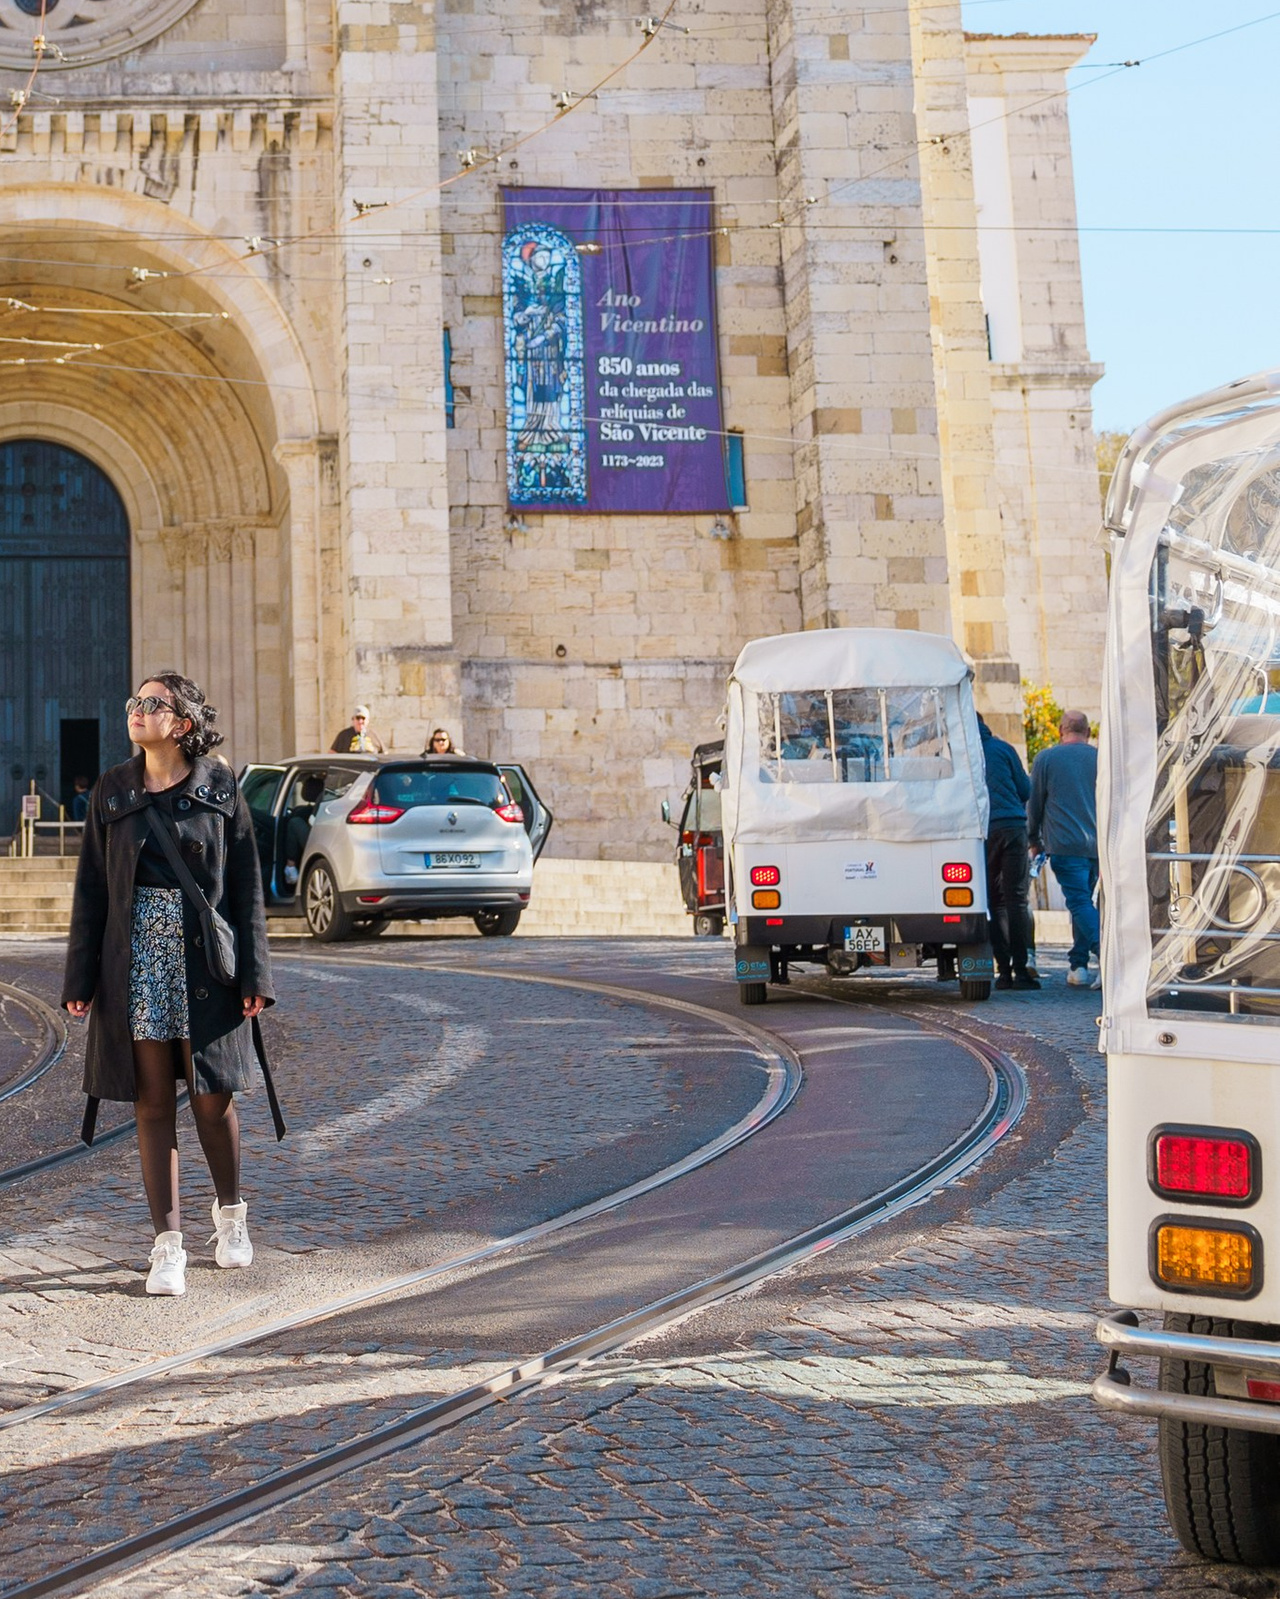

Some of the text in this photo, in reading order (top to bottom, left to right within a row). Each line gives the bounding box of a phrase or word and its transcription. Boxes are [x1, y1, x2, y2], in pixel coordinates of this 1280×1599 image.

[596, 288, 642, 308] Ano
[600, 312, 704, 334] Vicentino
[598, 357, 681, 377] 850 anos
[599, 381, 714, 402] da chegada das
[600, 403, 686, 424] relíquias de
[600, 421, 708, 442] São Vicente
[855, 928, 874, 940] AX
[848, 939, 881, 951] 56EP
